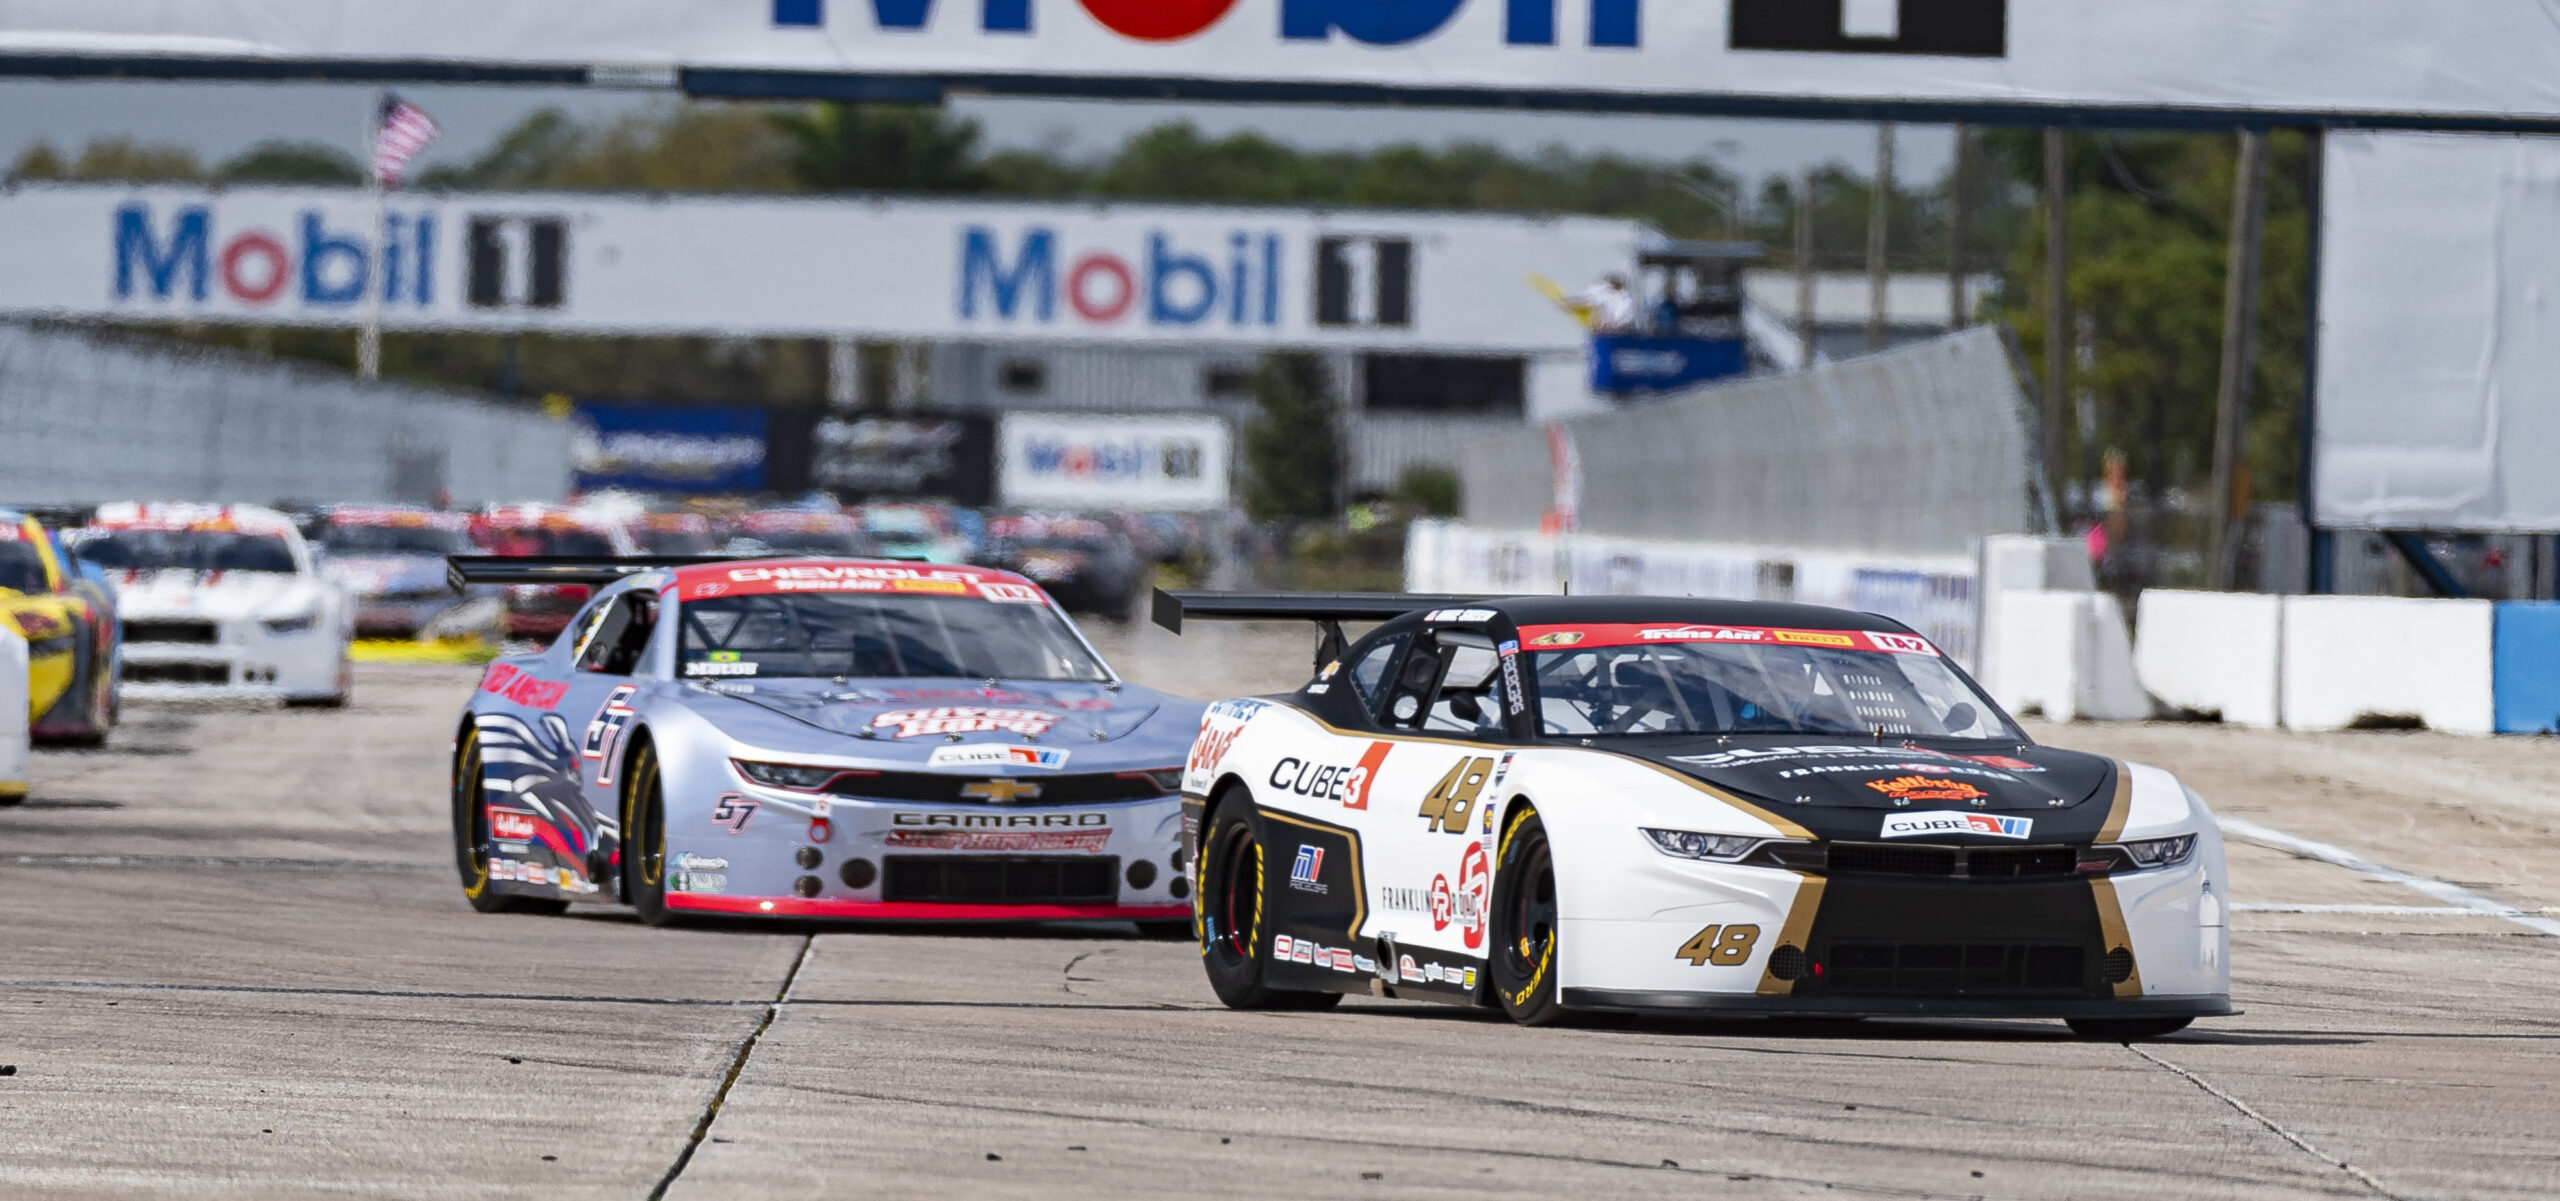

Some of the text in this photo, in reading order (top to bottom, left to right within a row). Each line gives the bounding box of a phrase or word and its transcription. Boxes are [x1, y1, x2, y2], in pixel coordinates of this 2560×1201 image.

[113, 203, 437, 306] Mobil
[956, 225, 1283, 326] Mobil
[727, 566, 982, 584] CHEVROLET
[1638, 630, 1764, 640] Trans Am
[1875, 635, 1927, 651] TA2
[1269, 756, 1368, 804] CUBE3
[1779, 762, 1901, 779] FRANKLIN
[1418, 756, 1494, 835] 48
[711, 791, 760, 836] 57
[892, 812, 1109, 828] CAMARO
[1890, 820, 1990, 833] CUBE3
[1382, 886, 1432, 913] FRANKLIN
[1674, 923, 1762, 967] 48
